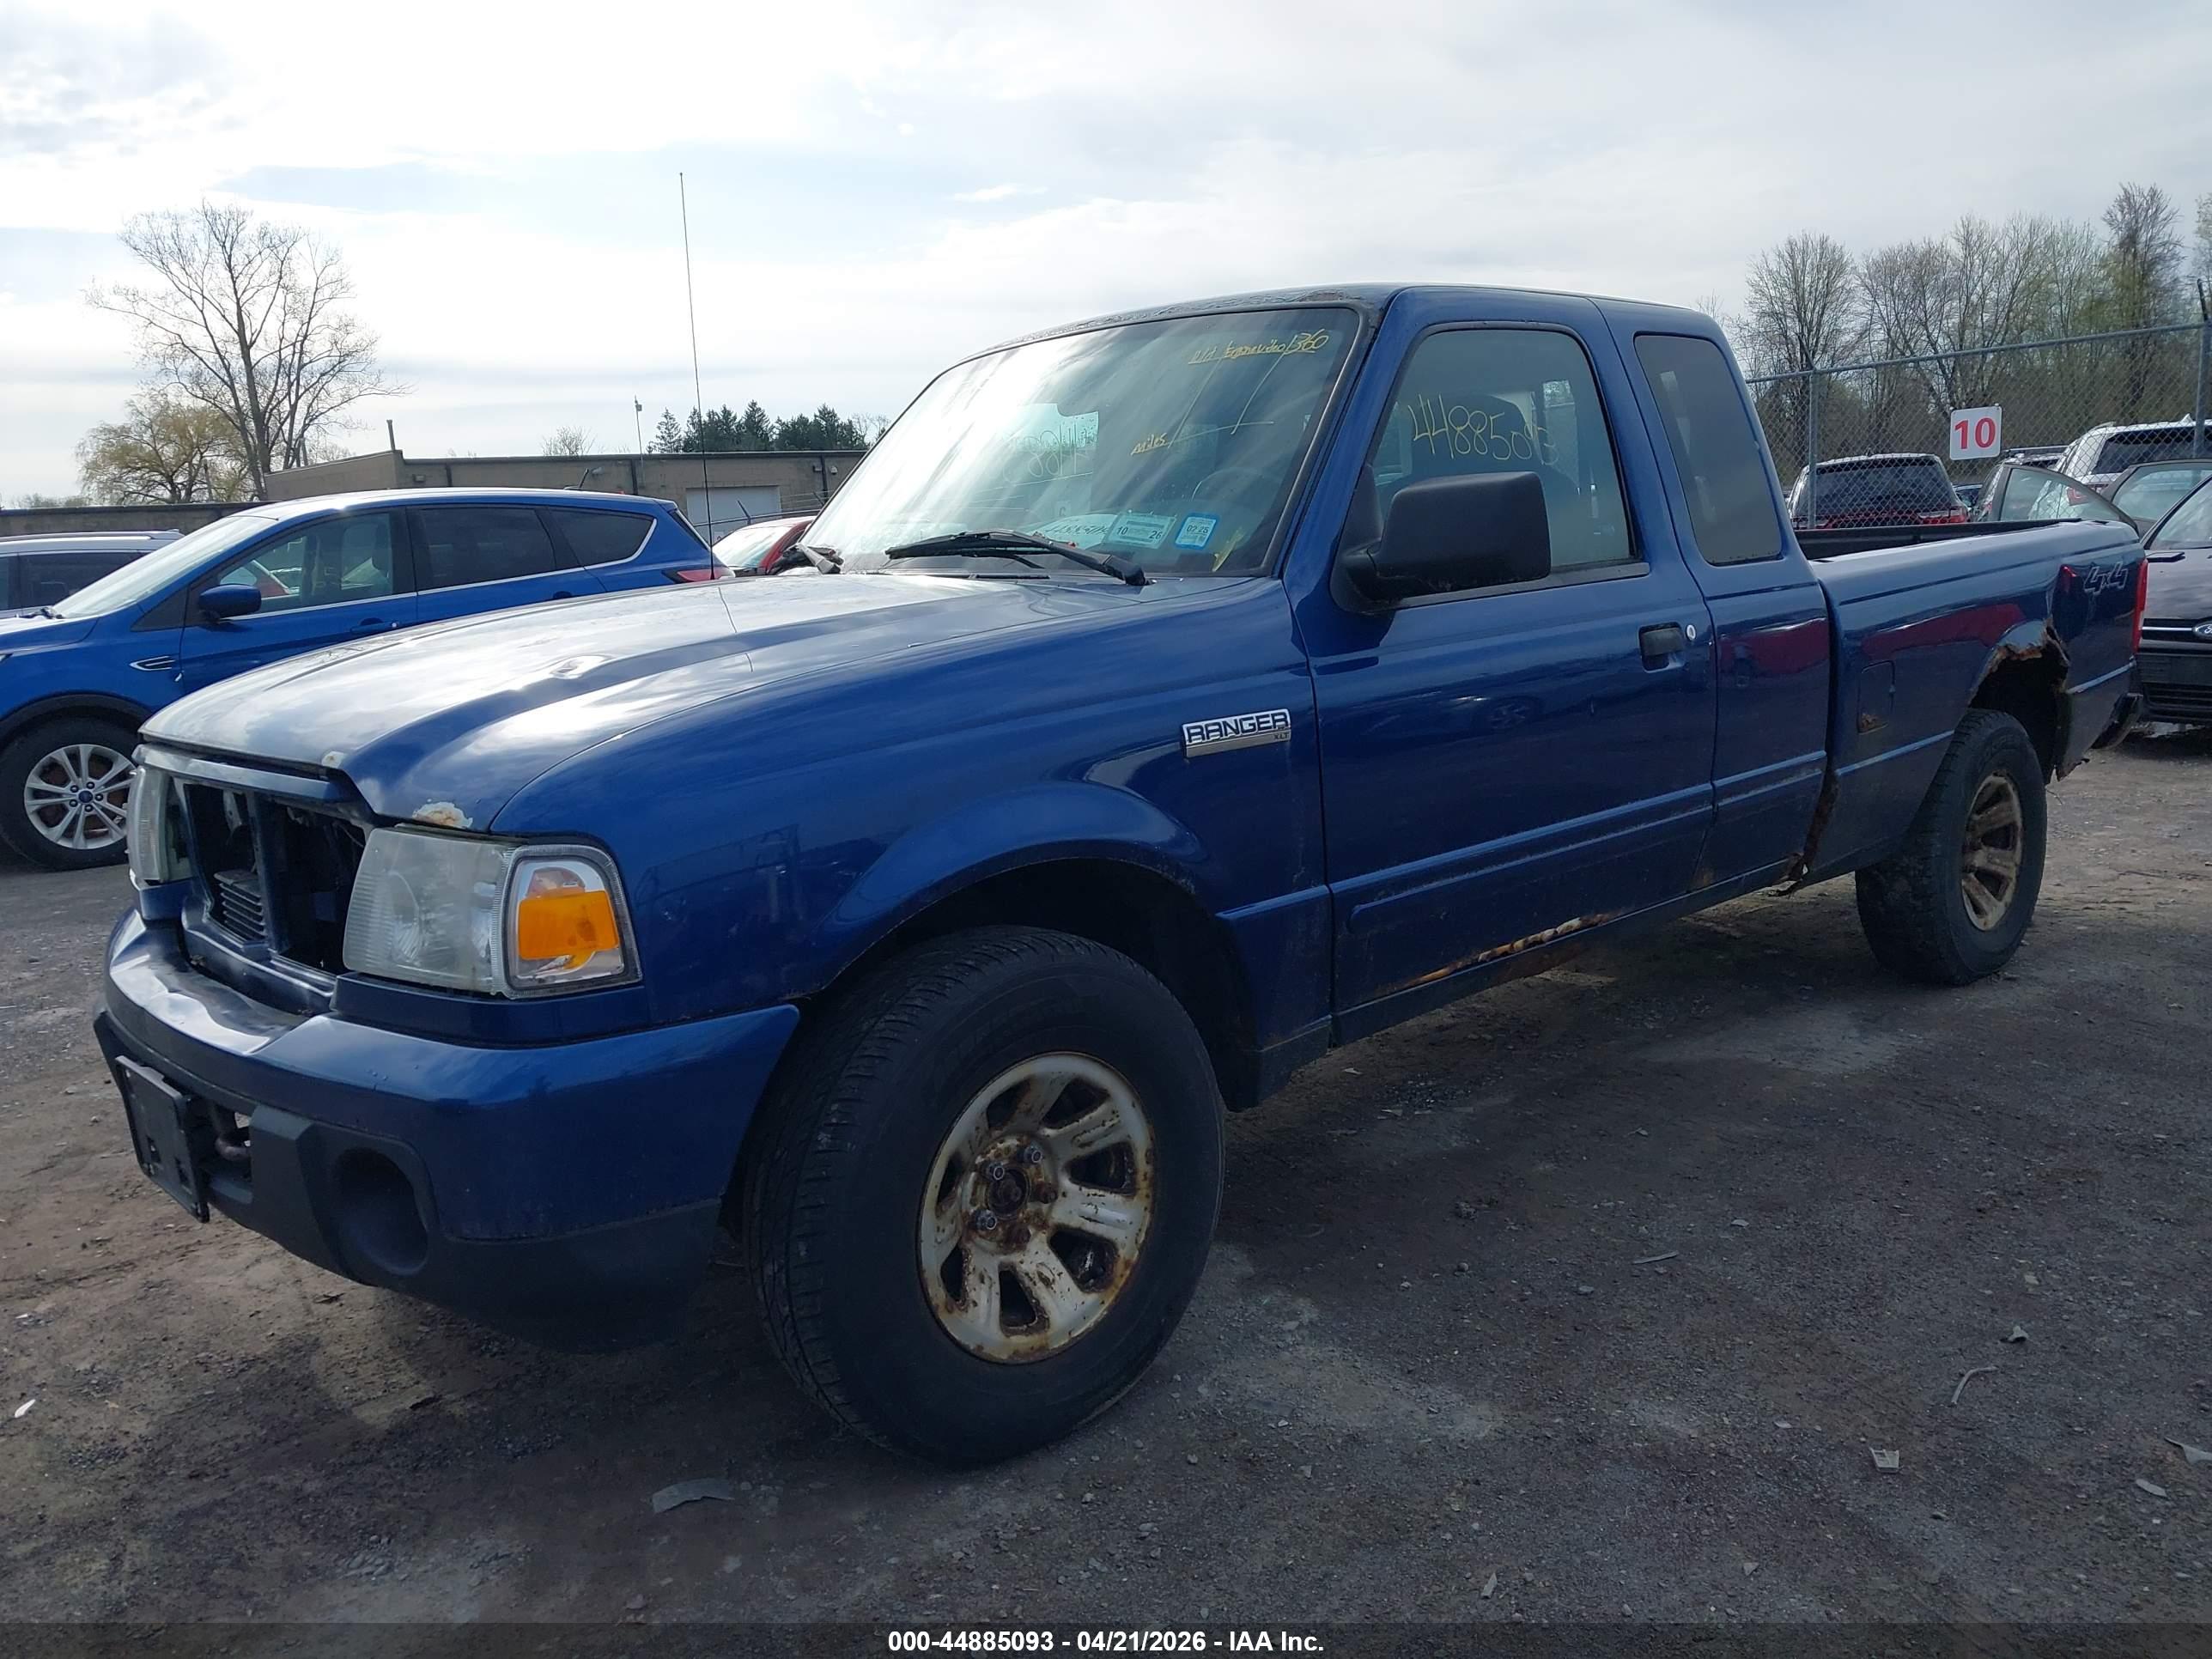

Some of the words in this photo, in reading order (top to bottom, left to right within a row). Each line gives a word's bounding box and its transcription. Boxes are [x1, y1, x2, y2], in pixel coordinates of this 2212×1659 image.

[1954, 416, 1996, 450] 10
[1116, 526, 1128, 535] 10
[1149, 530, 1163, 539] 26
[1186, 711, 1289, 744] RANGER
